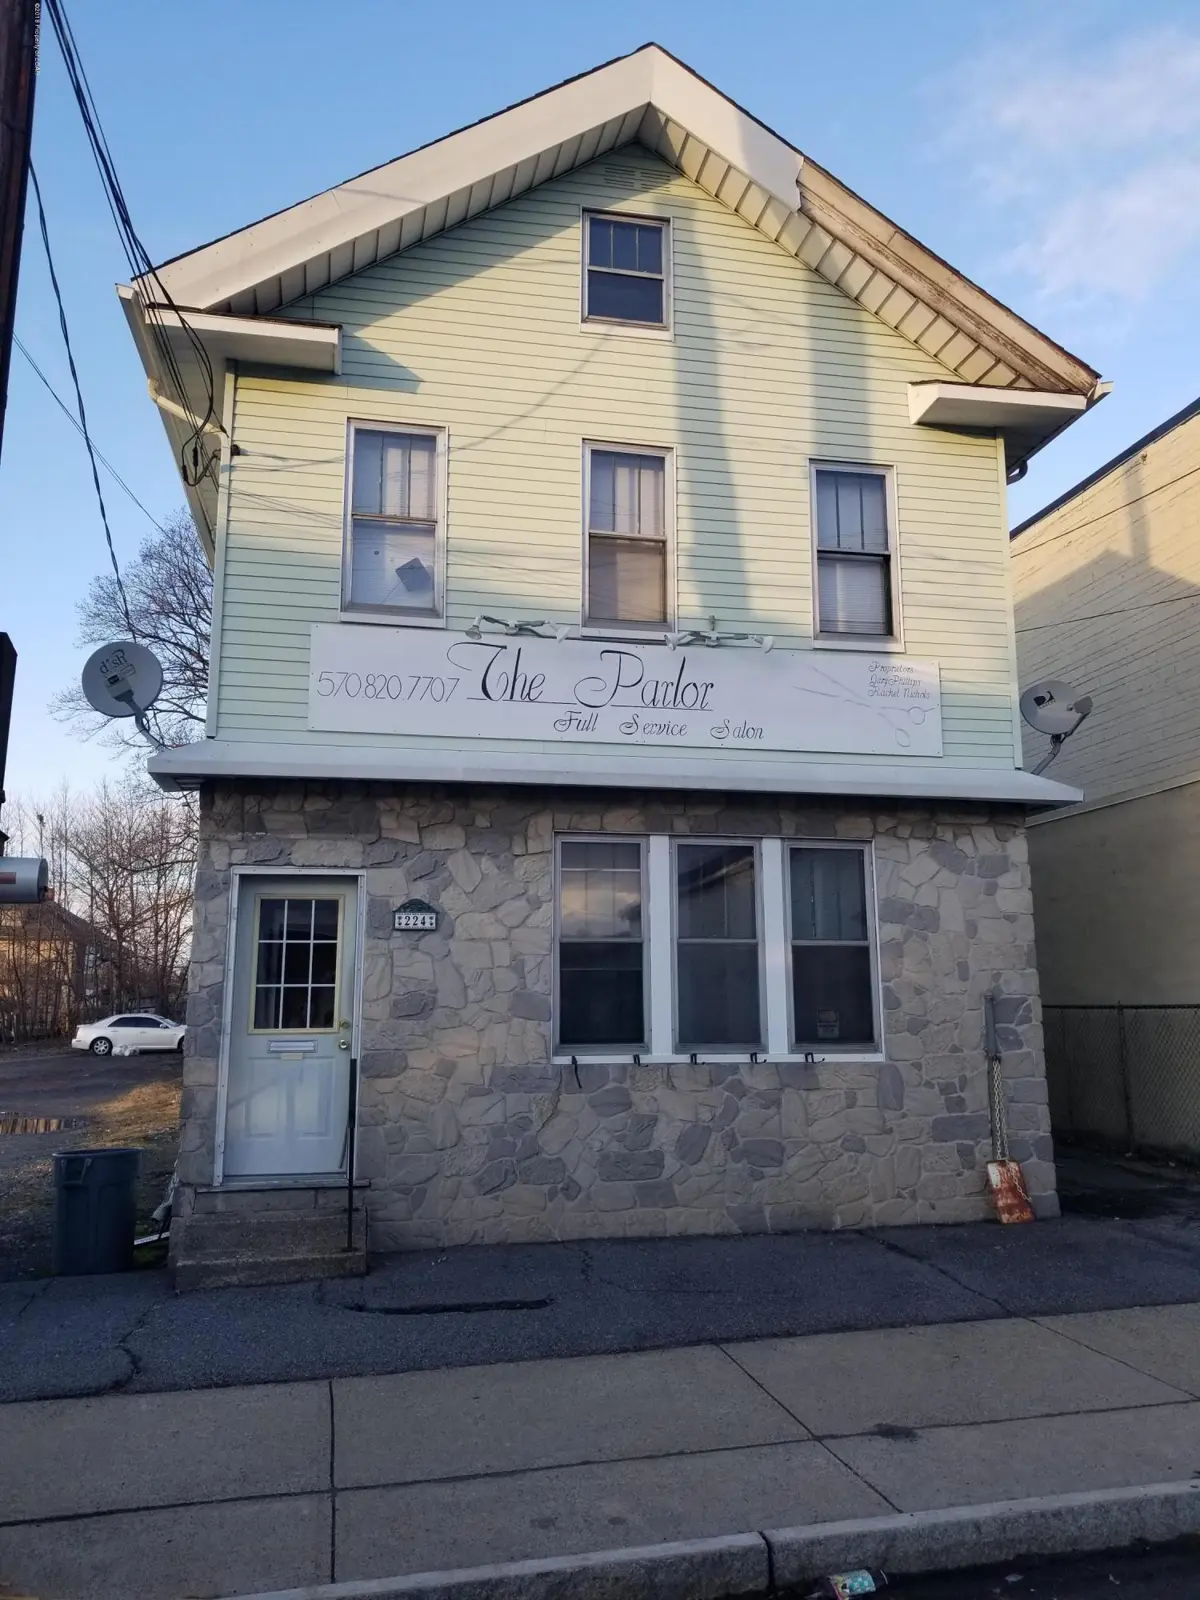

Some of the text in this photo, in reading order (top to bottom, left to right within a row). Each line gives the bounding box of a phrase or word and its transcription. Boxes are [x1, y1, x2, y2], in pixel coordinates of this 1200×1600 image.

[447, 642, 714, 709] The Parlor
[553, 710, 765, 740] Full Service Salon
[404, 915, 426, 926] 224
